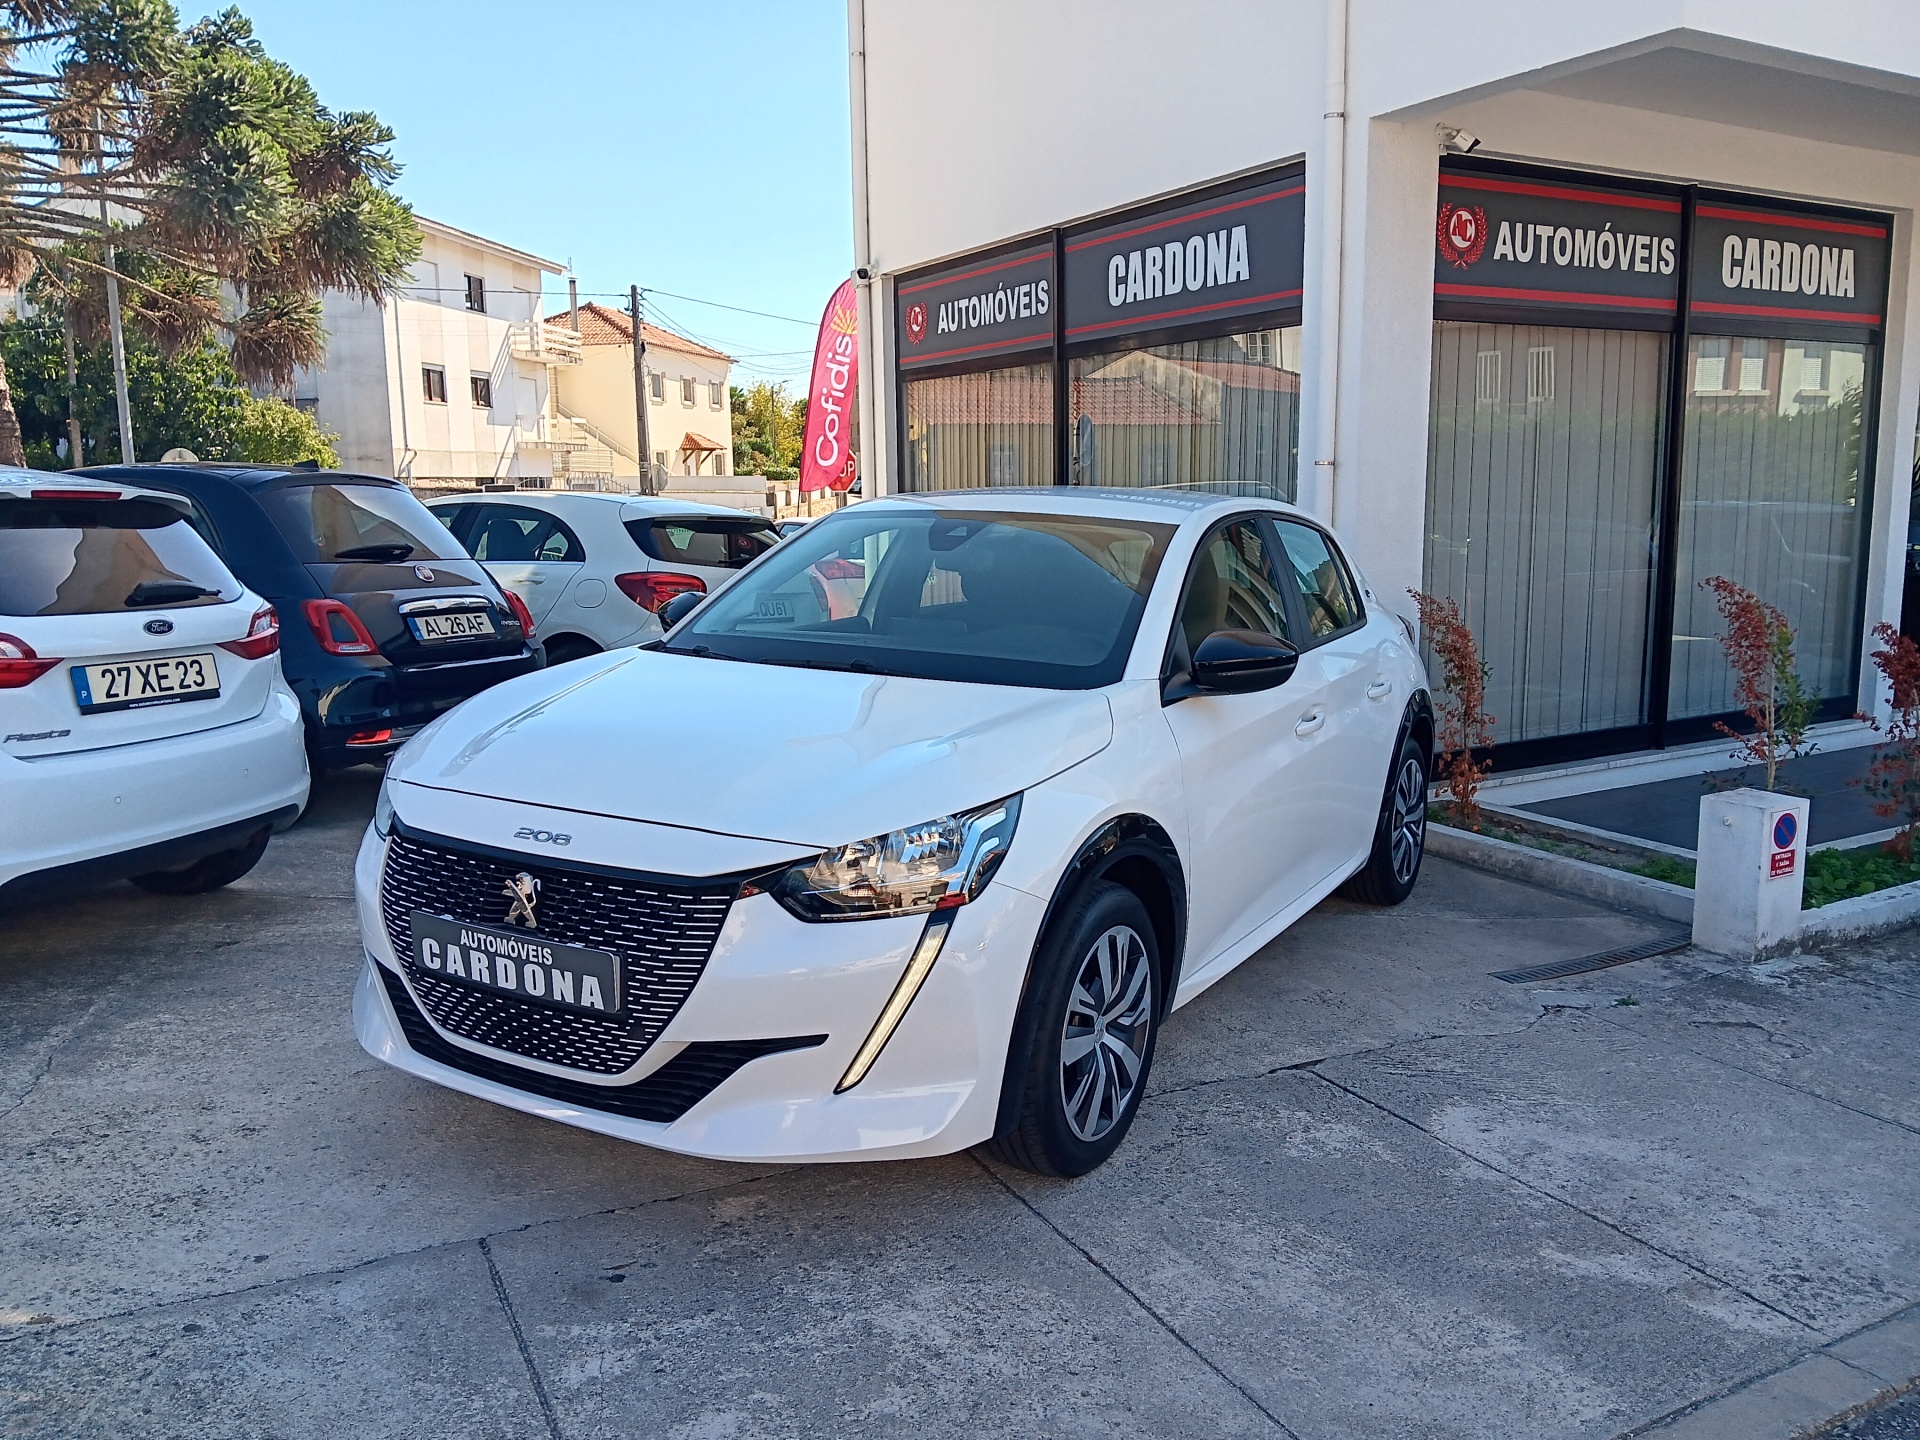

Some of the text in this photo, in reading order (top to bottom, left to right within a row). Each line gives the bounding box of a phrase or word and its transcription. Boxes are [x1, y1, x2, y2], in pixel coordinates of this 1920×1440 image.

[937, 225, 1250, 334] AUTOMÓVEIS CARDONA
[1493, 221, 1855, 298] AUTOMÓVEIS CARDONA
[816, 335, 852, 467] Cofidis
[151, 622, 168, 632] Ford
[3, 729, 71, 743] Fiesta
[513, 827, 573, 846] 208
[421, 937, 605, 1010] CARDONA
[460, 929, 553, 965] AUTOMÓVEIS
